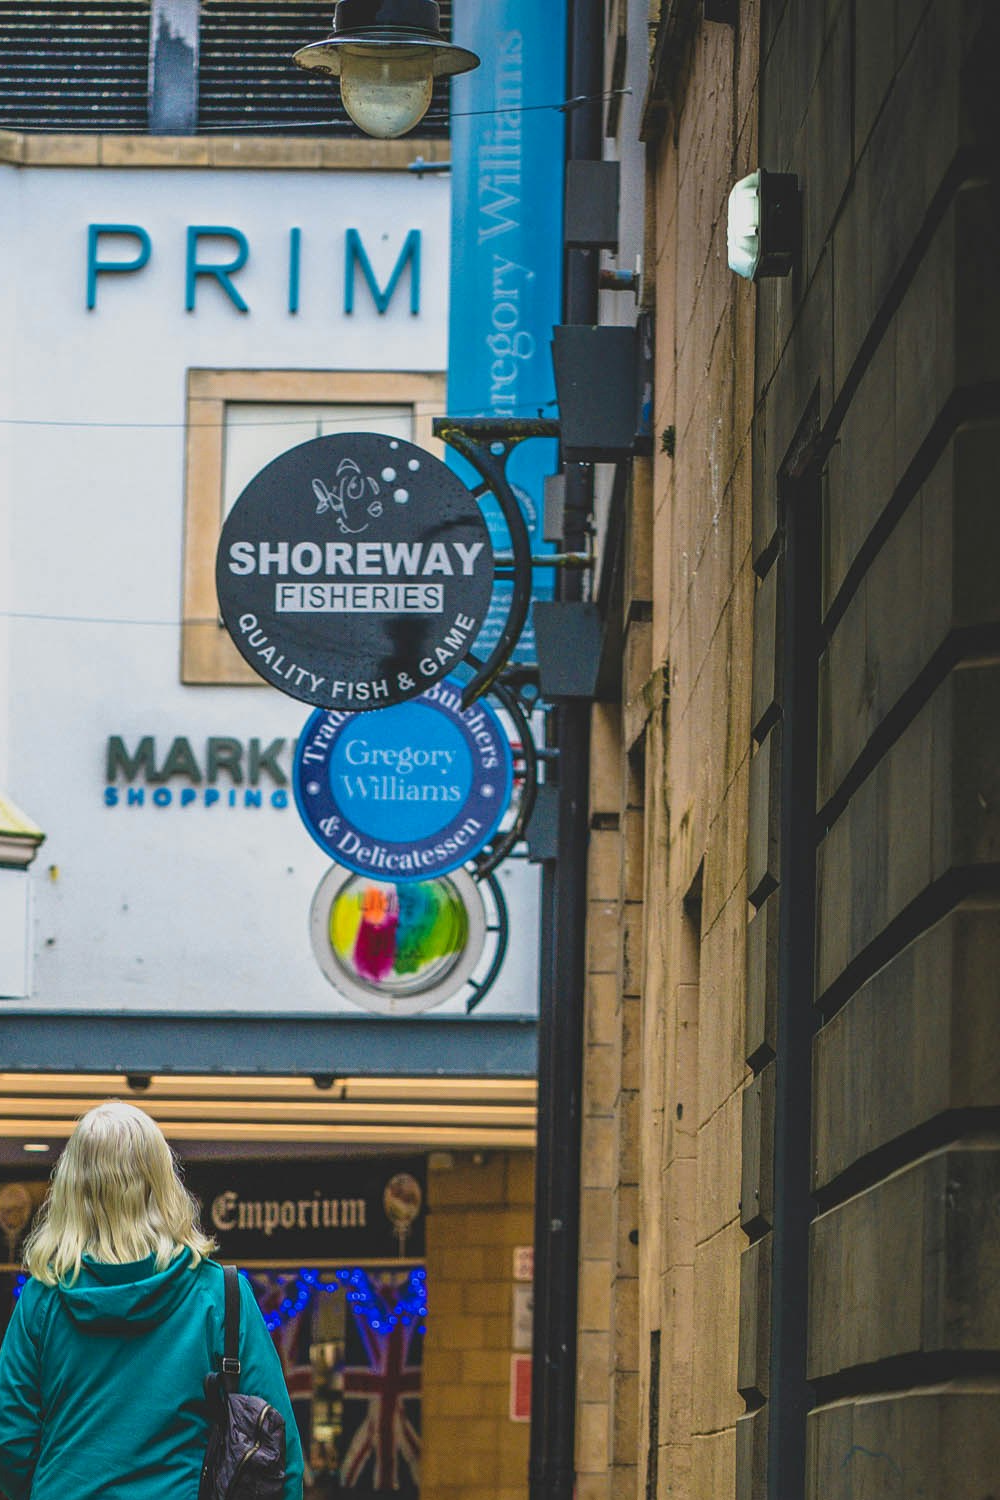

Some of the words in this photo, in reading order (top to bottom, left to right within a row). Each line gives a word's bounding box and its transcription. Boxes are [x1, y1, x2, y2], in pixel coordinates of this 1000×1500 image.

[478, 29, 523, 246] Williams
[86, 223, 422, 315] PRIM
[474, 253, 537, 418] regory
[228, 541, 485, 576] SHOREWAY
[280, 585, 440, 609] FISHERIES
[238, 612, 325, 693] QUALITY
[331, 679, 389, 700] FISH
[397, 671, 416, 691] &
[419, 612, 476, 677] GAME
[105, 735, 298, 787] MARK
[302, 708, 352, 765] Trad
[345, 739, 457, 775] Gregory
[104, 785, 290, 810] SHOPPING
[340, 774, 461, 802] Williams
[319, 814, 341, 837] &
[336, 817, 483, 871] Delicatessen
[211, 1190, 367, 1236] Emporium
